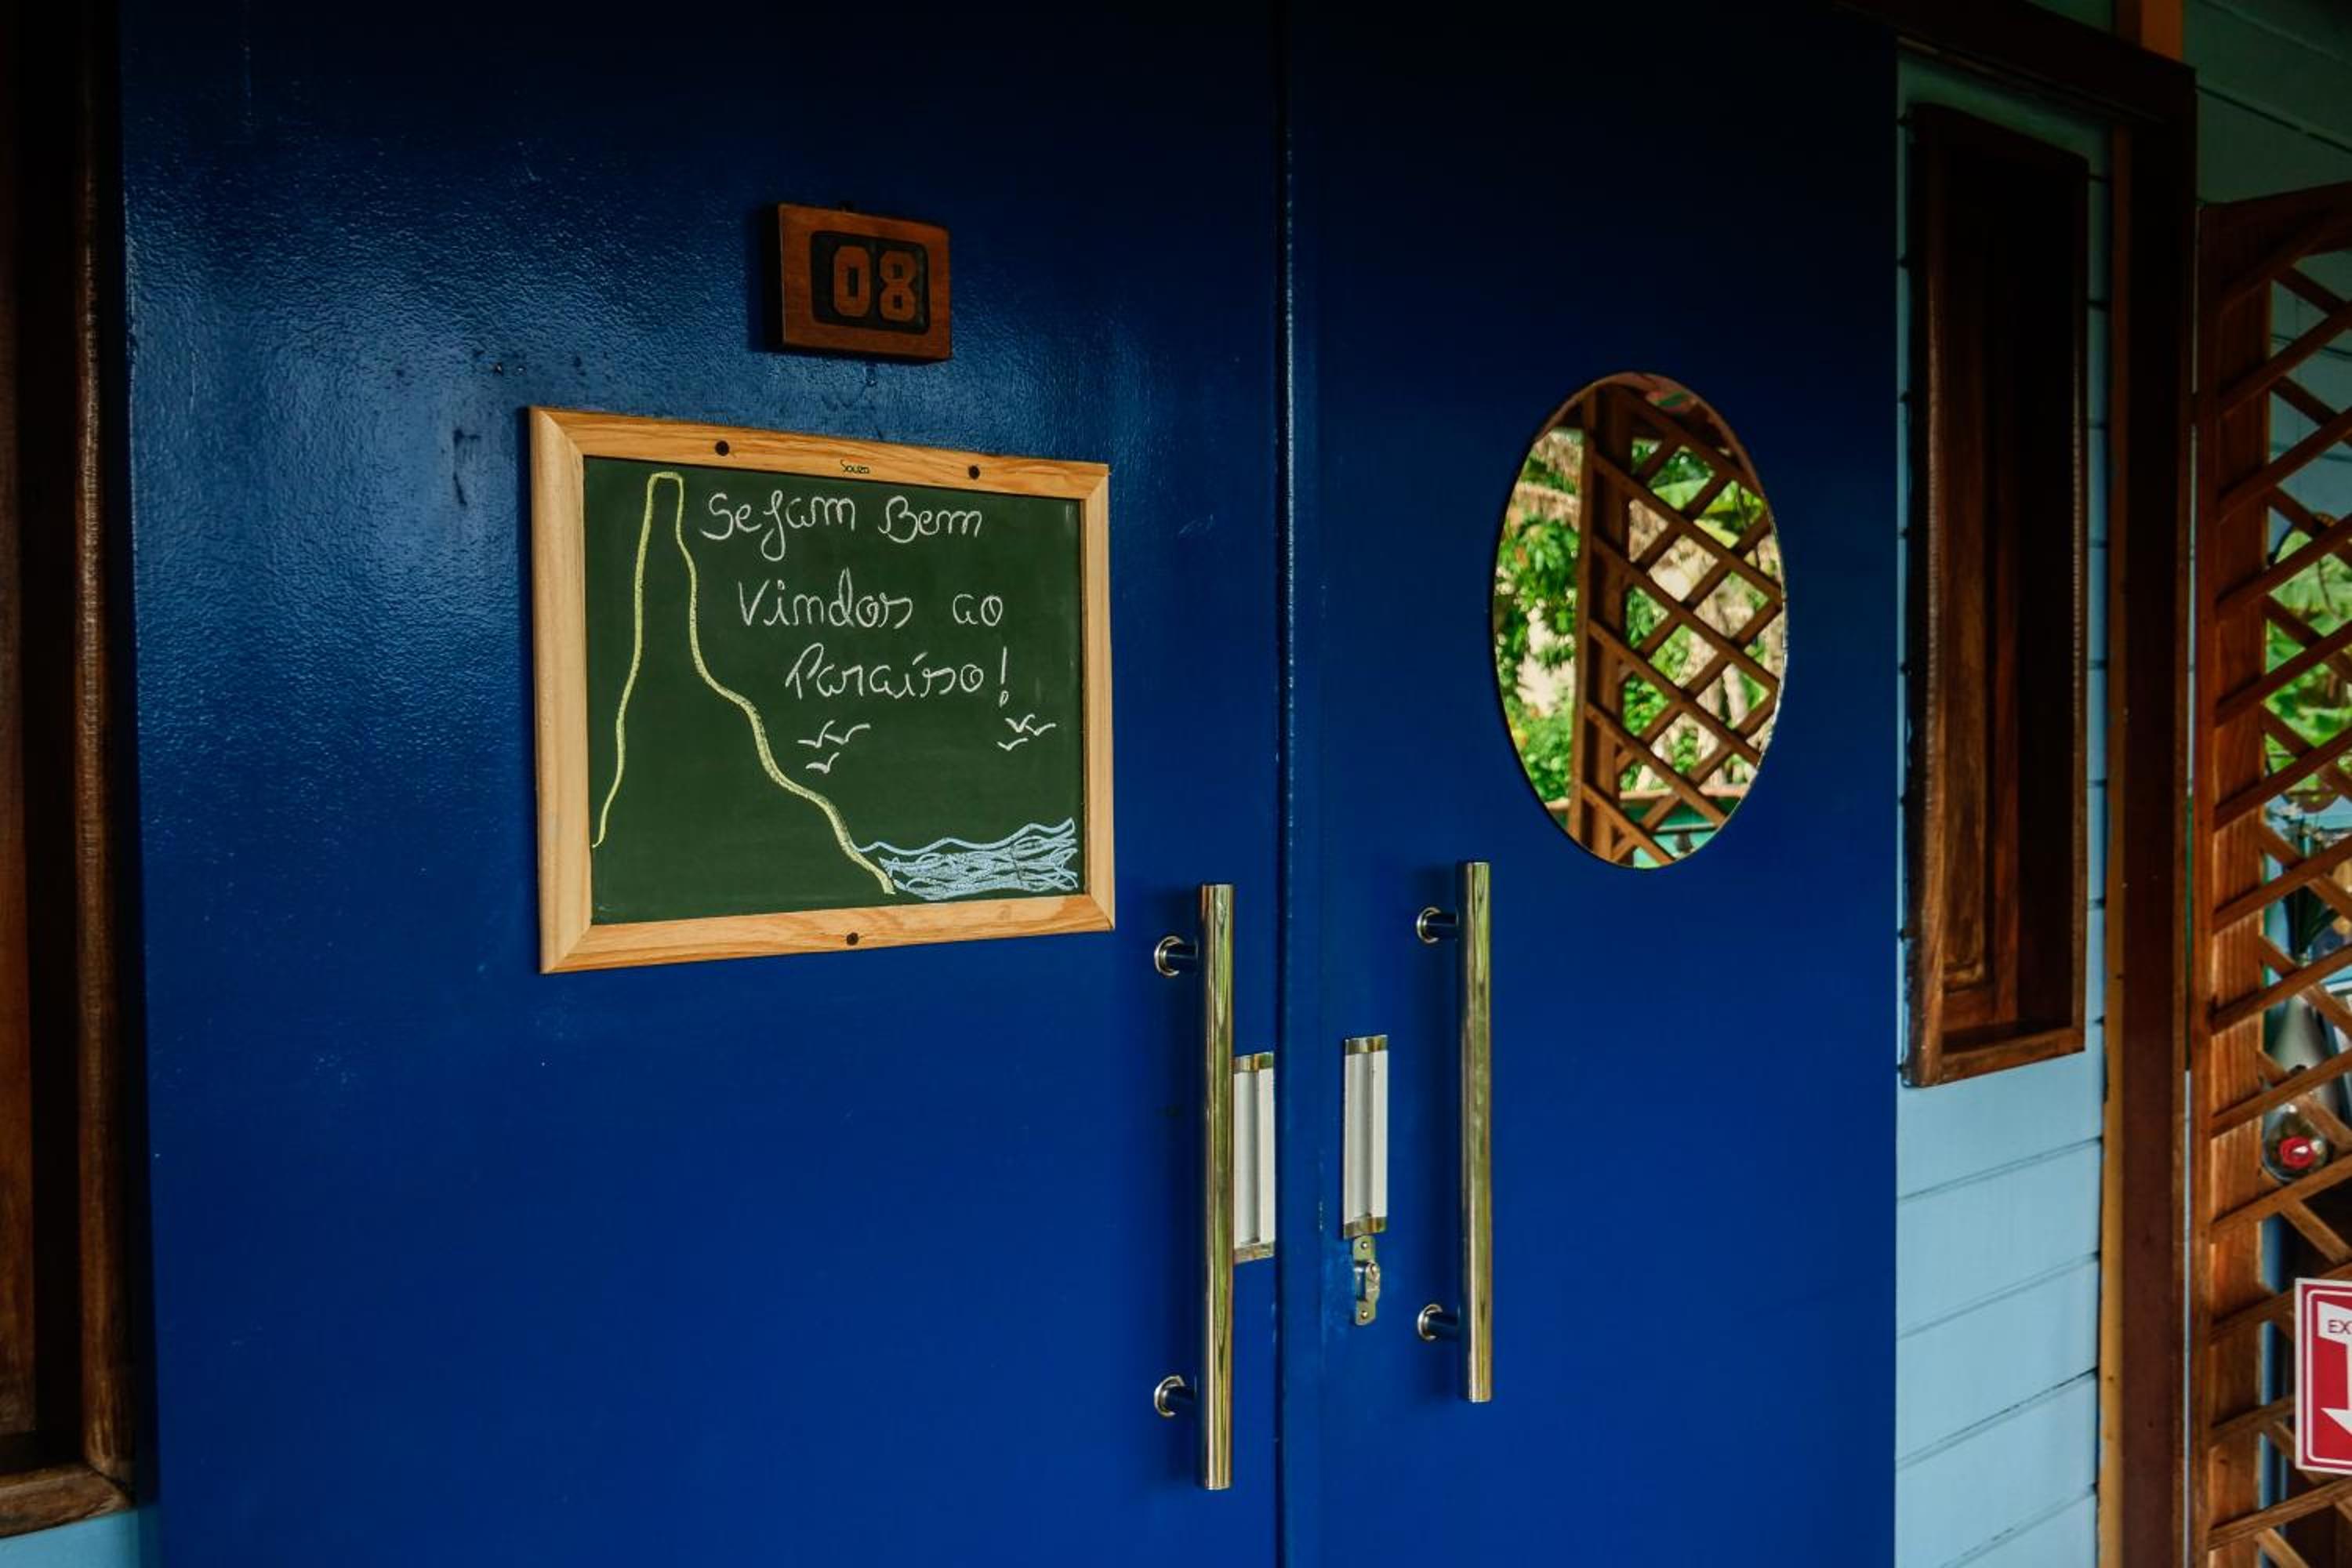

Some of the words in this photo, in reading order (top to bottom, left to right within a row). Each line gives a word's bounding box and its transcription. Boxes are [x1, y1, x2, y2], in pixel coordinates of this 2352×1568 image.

[834, 245, 916, 322] 08
[700, 489, 855, 561] Sejam
[878, 495, 982, 543] Bem
[738, 567, 913, 629] Vindos
[953, 593, 1004, 626] ao
